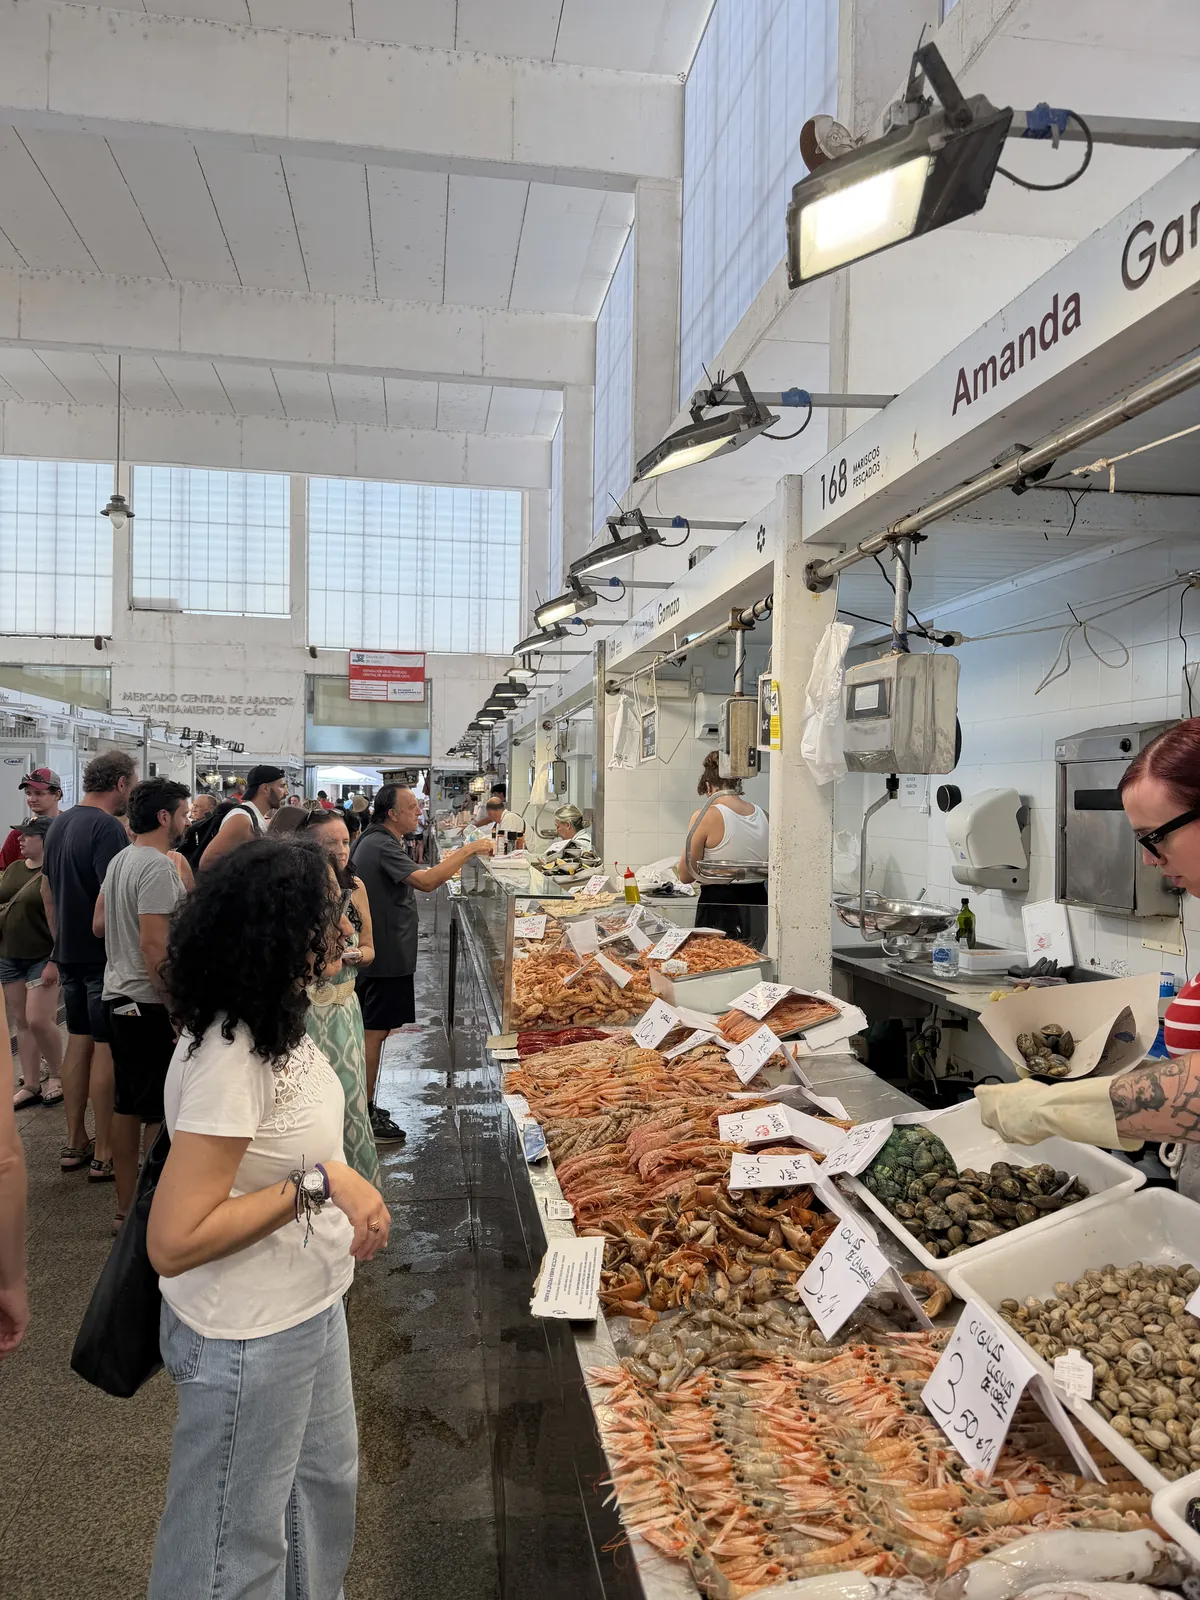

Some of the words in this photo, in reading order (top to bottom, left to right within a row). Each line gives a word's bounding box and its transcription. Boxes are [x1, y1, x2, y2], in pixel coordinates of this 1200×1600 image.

[951, 291, 1083, 417] Amanda
[852, 445, 880, 475] MARISCOS
[821, 458, 847, 510] 168
[852, 461, 881, 489] PESCADOS
[122, 691, 178, 702] MERCADO
[179, 693, 228, 704] CENTRAL
[231, 695, 245, 705] DE
[246, 695, 294, 706] ABASTOS
[138, 703, 225, 715] AYUNTAMIENTO
[227, 706, 242, 716] DE
[243, 704, 278, 717] CÁDIZ
[840, 1224, 866, 1252] COLAS
